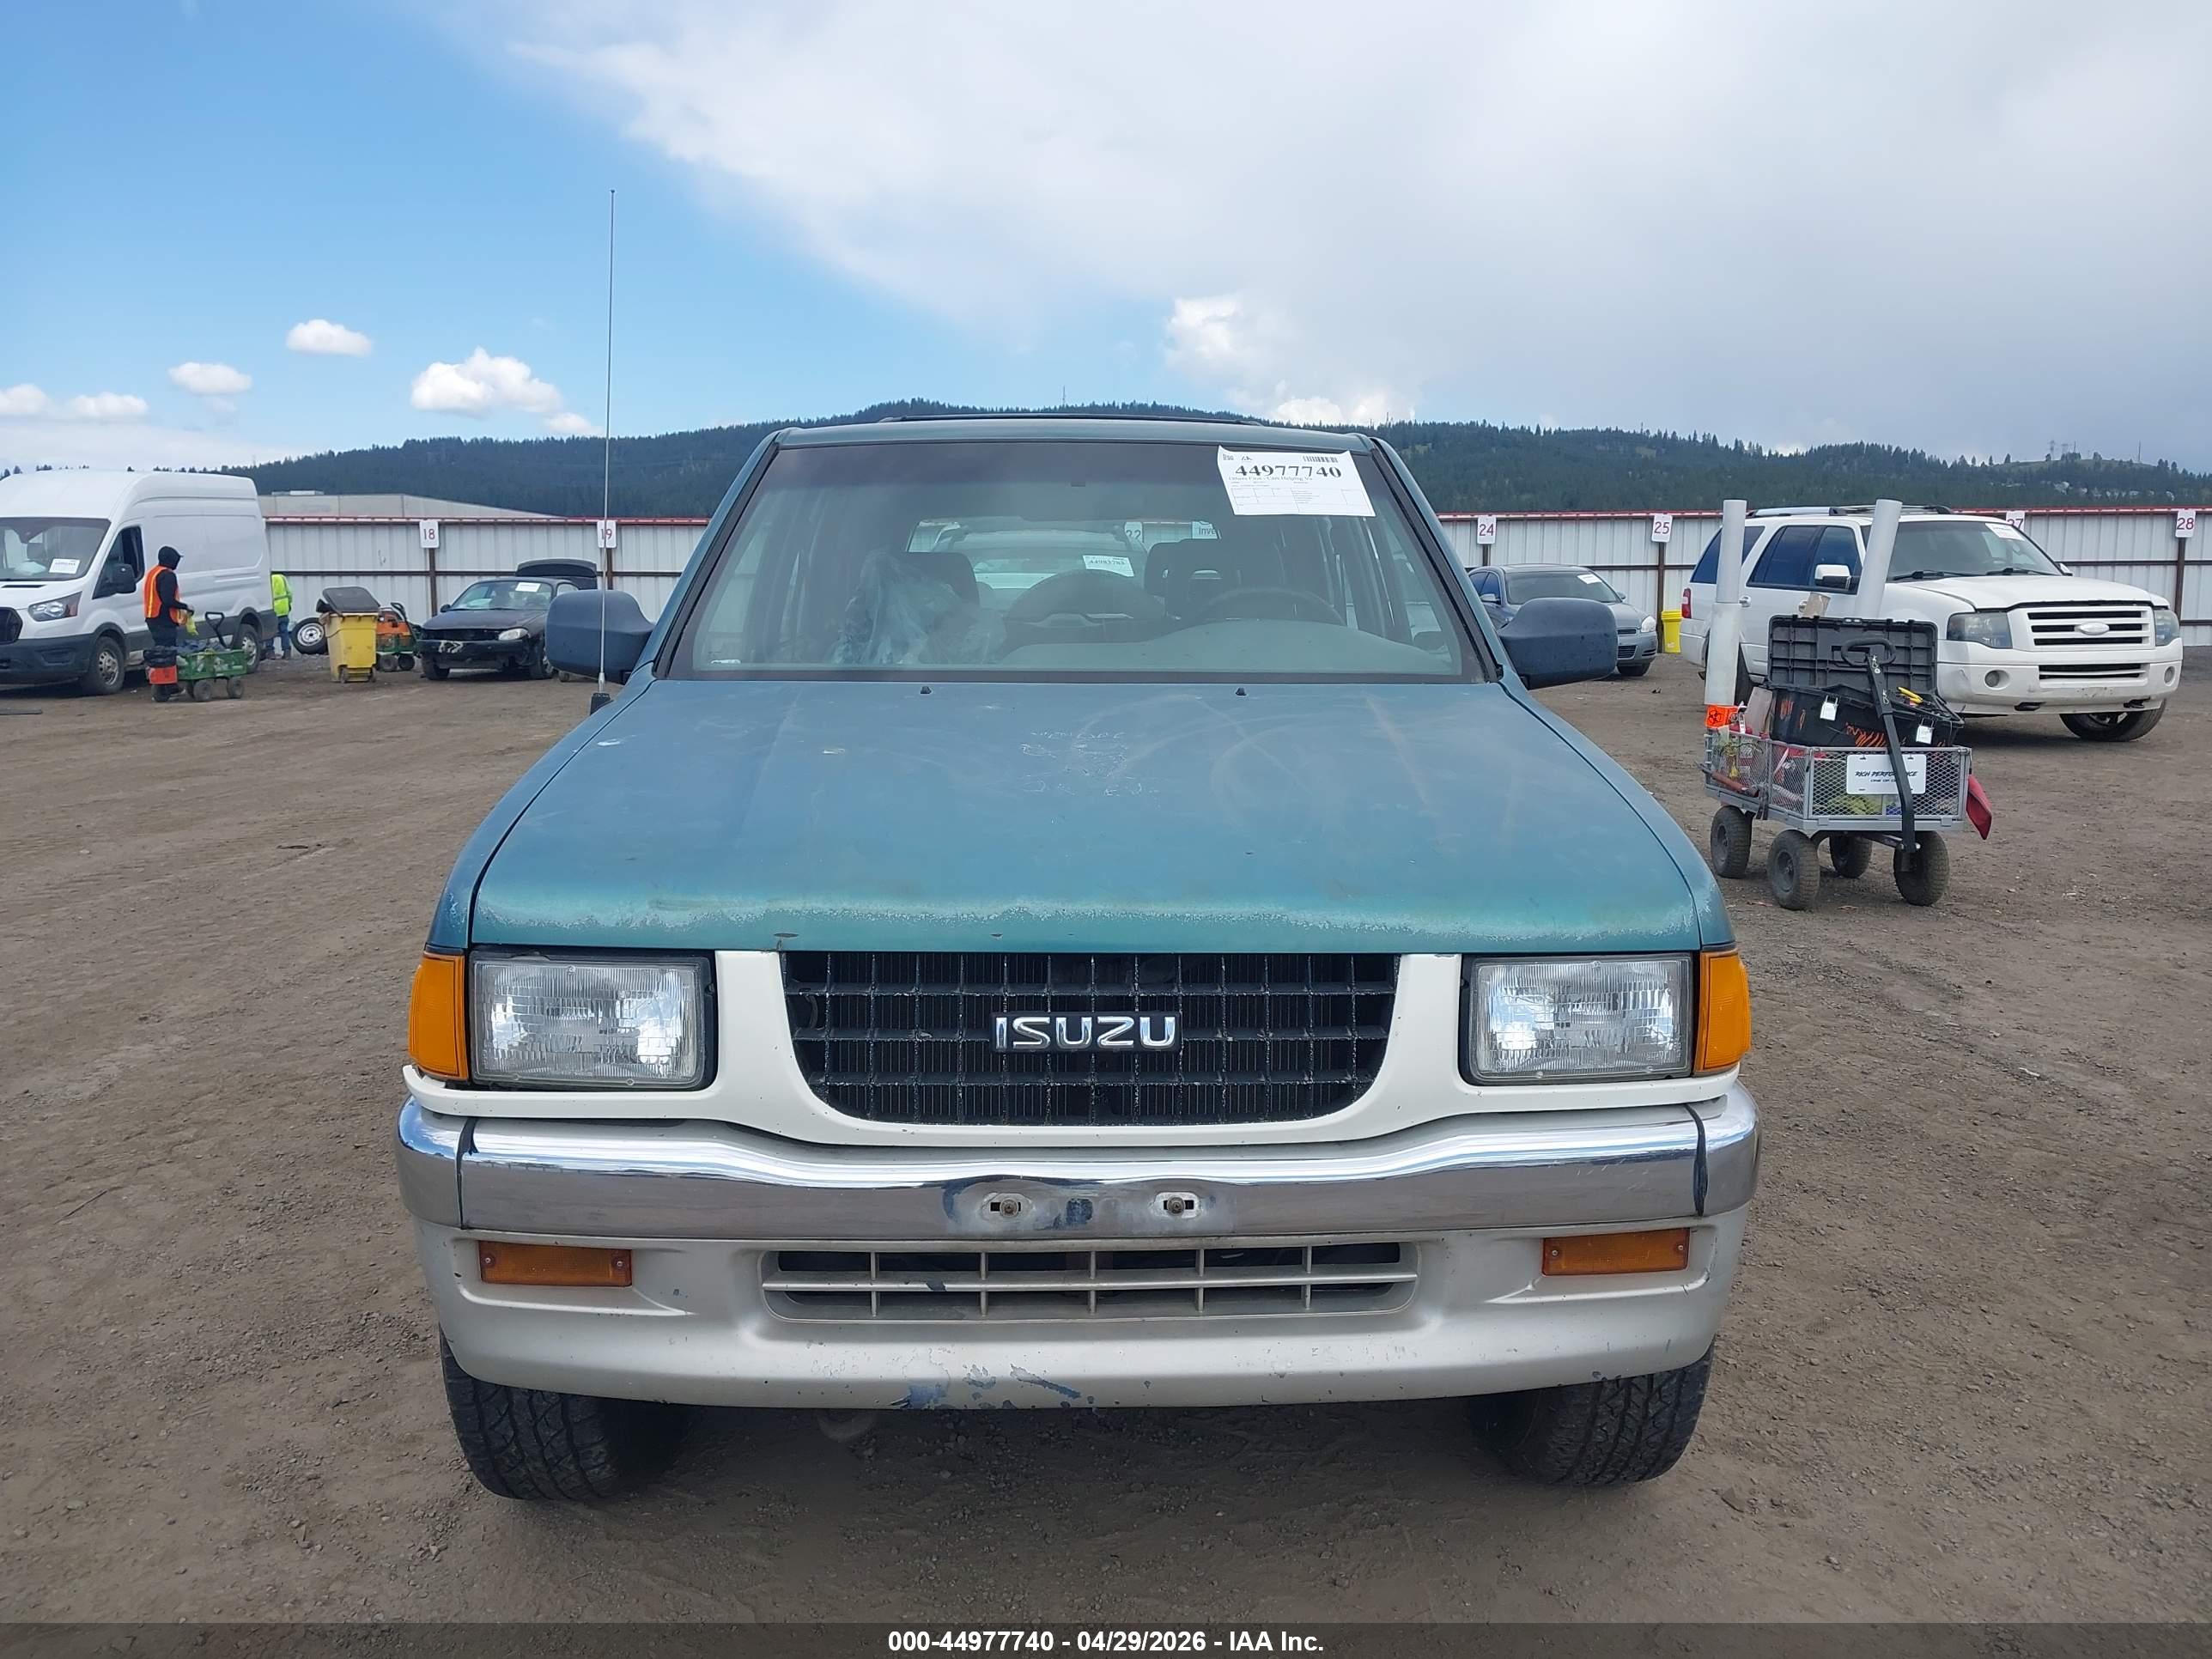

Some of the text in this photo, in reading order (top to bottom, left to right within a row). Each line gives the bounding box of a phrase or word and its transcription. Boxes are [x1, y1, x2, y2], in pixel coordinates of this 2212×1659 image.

[1235, 465, 1341, 478] 44977740
[1479, 523, 1494, 537] 24
[1654, 521, 1670, 534] 25
[2176, 517, 2195, 530] 28
[423, 528, 435, 540] 18
[601, 528, 612, 540] 19
[995, 1016, 1176, 1049] ISUZU
